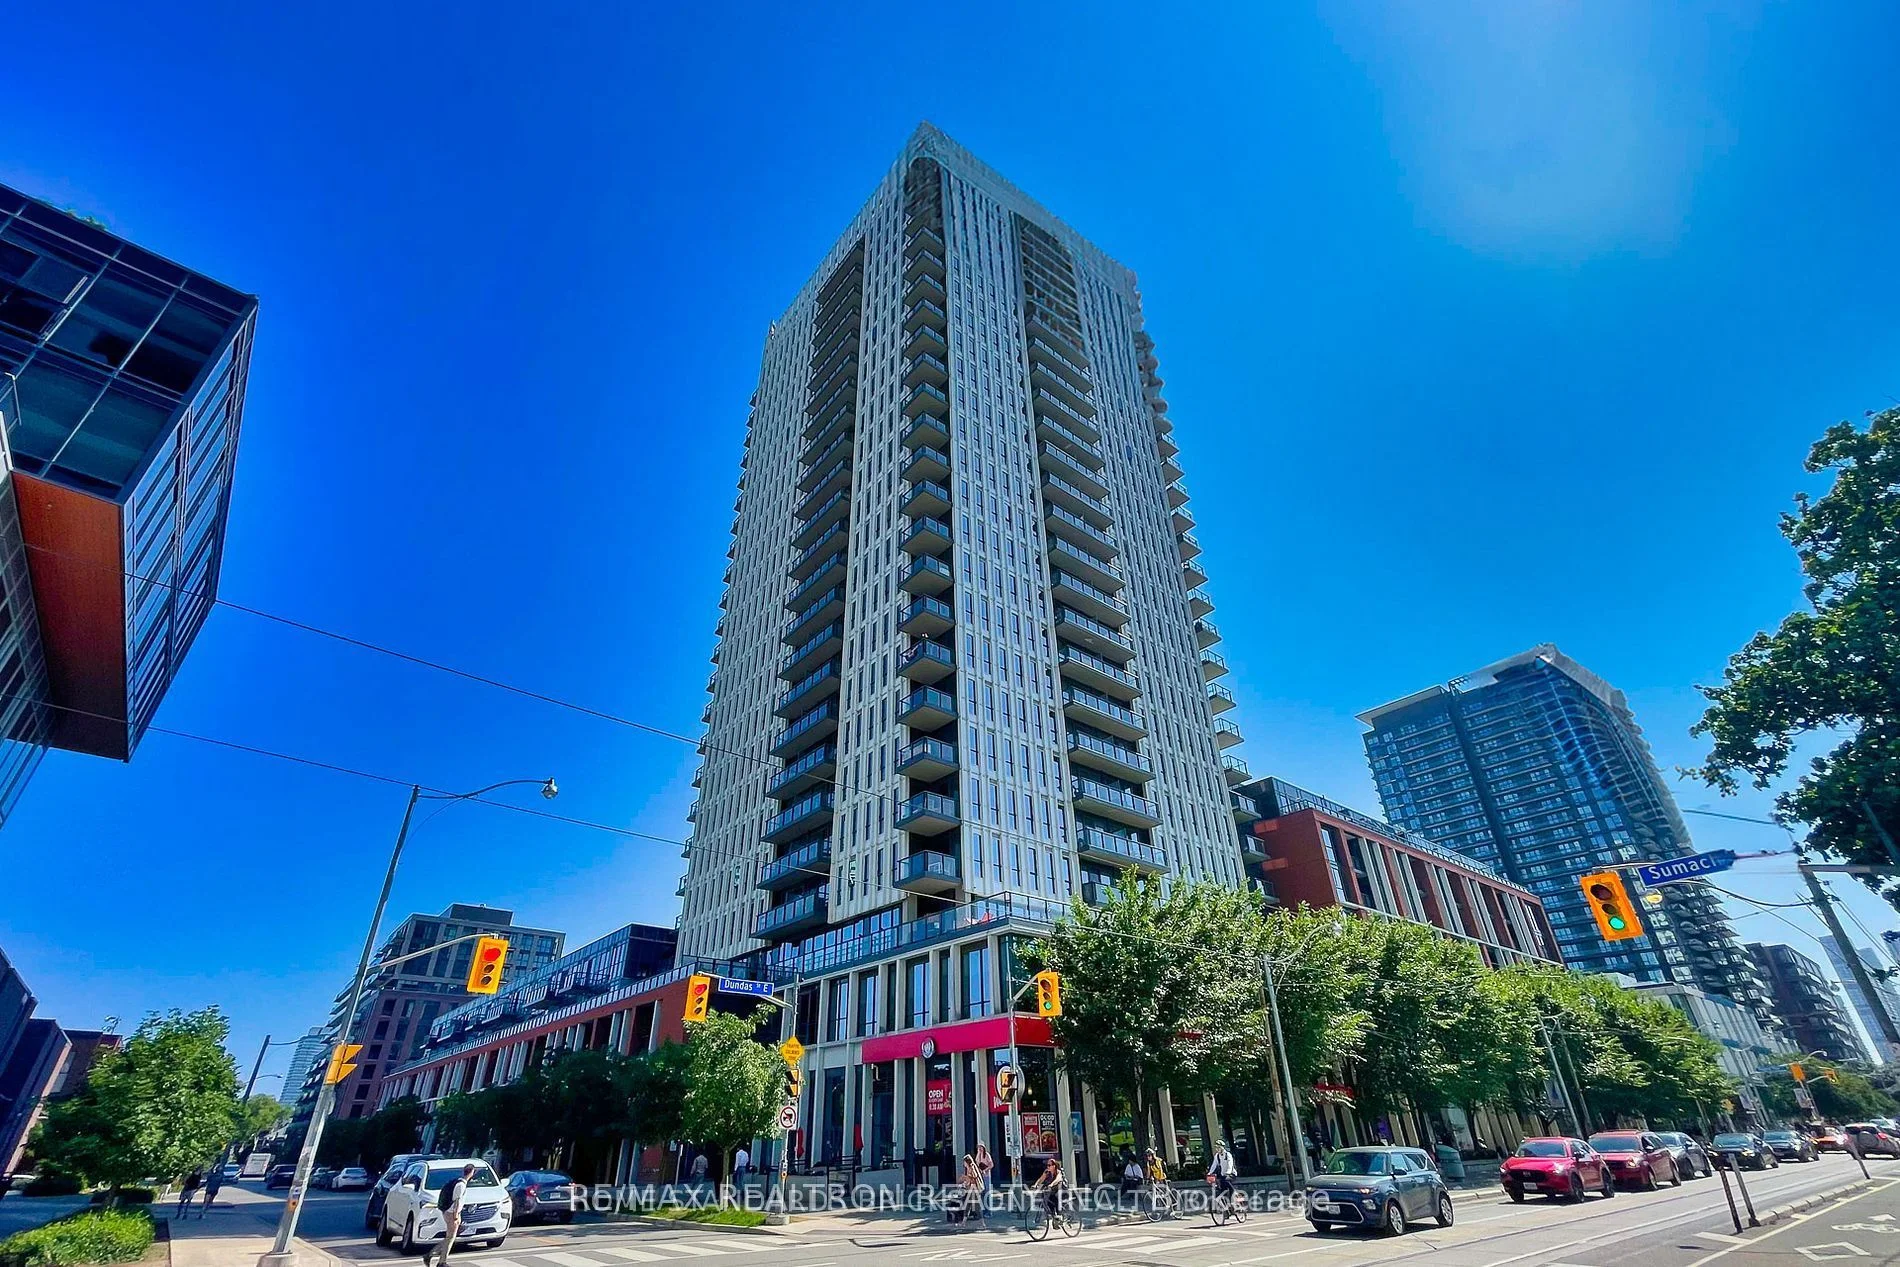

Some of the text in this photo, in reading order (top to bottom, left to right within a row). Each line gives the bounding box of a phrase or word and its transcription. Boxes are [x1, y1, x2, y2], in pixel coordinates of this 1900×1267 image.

[724, 979, 753, 991] Dundas
[763, 984, 769, 993] E
[928, 1089, 944, 1099] OPEN
